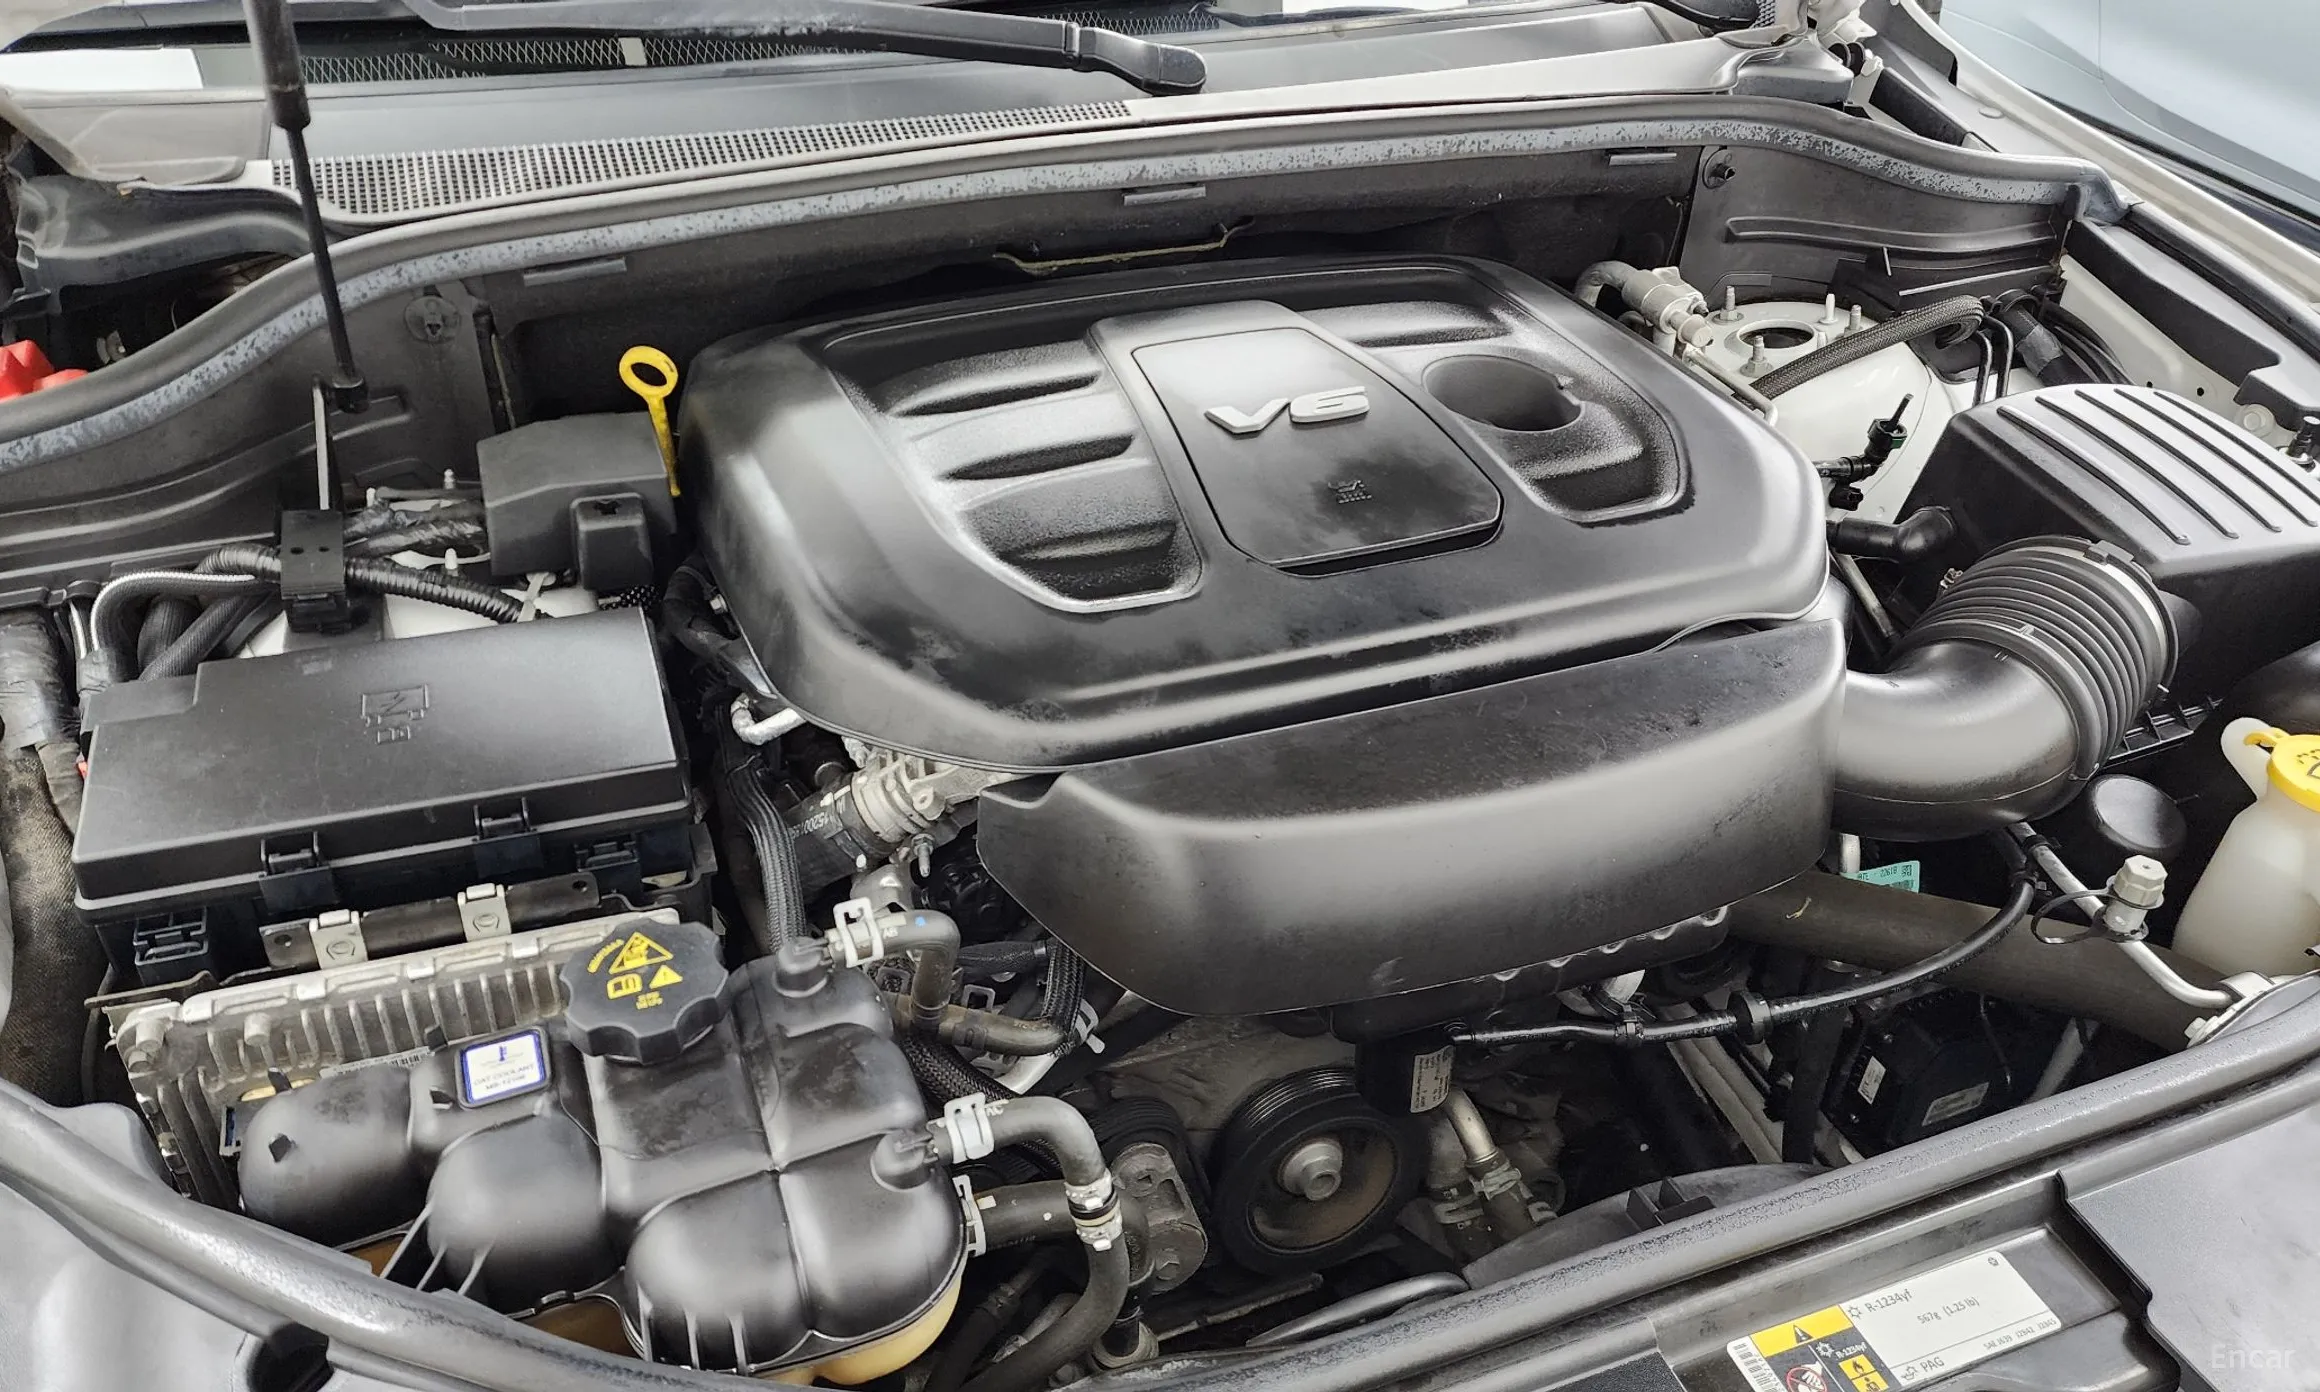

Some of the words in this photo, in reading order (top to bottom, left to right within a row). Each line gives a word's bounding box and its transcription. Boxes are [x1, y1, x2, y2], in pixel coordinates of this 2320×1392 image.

[1202, 386, 1370, 434] V6
[1864, 1288, 1913, 1313] R-1234yf
[1917, 1311, 1942, 1325] 567g
[1919, 1356, 1945, 1373] PAG
